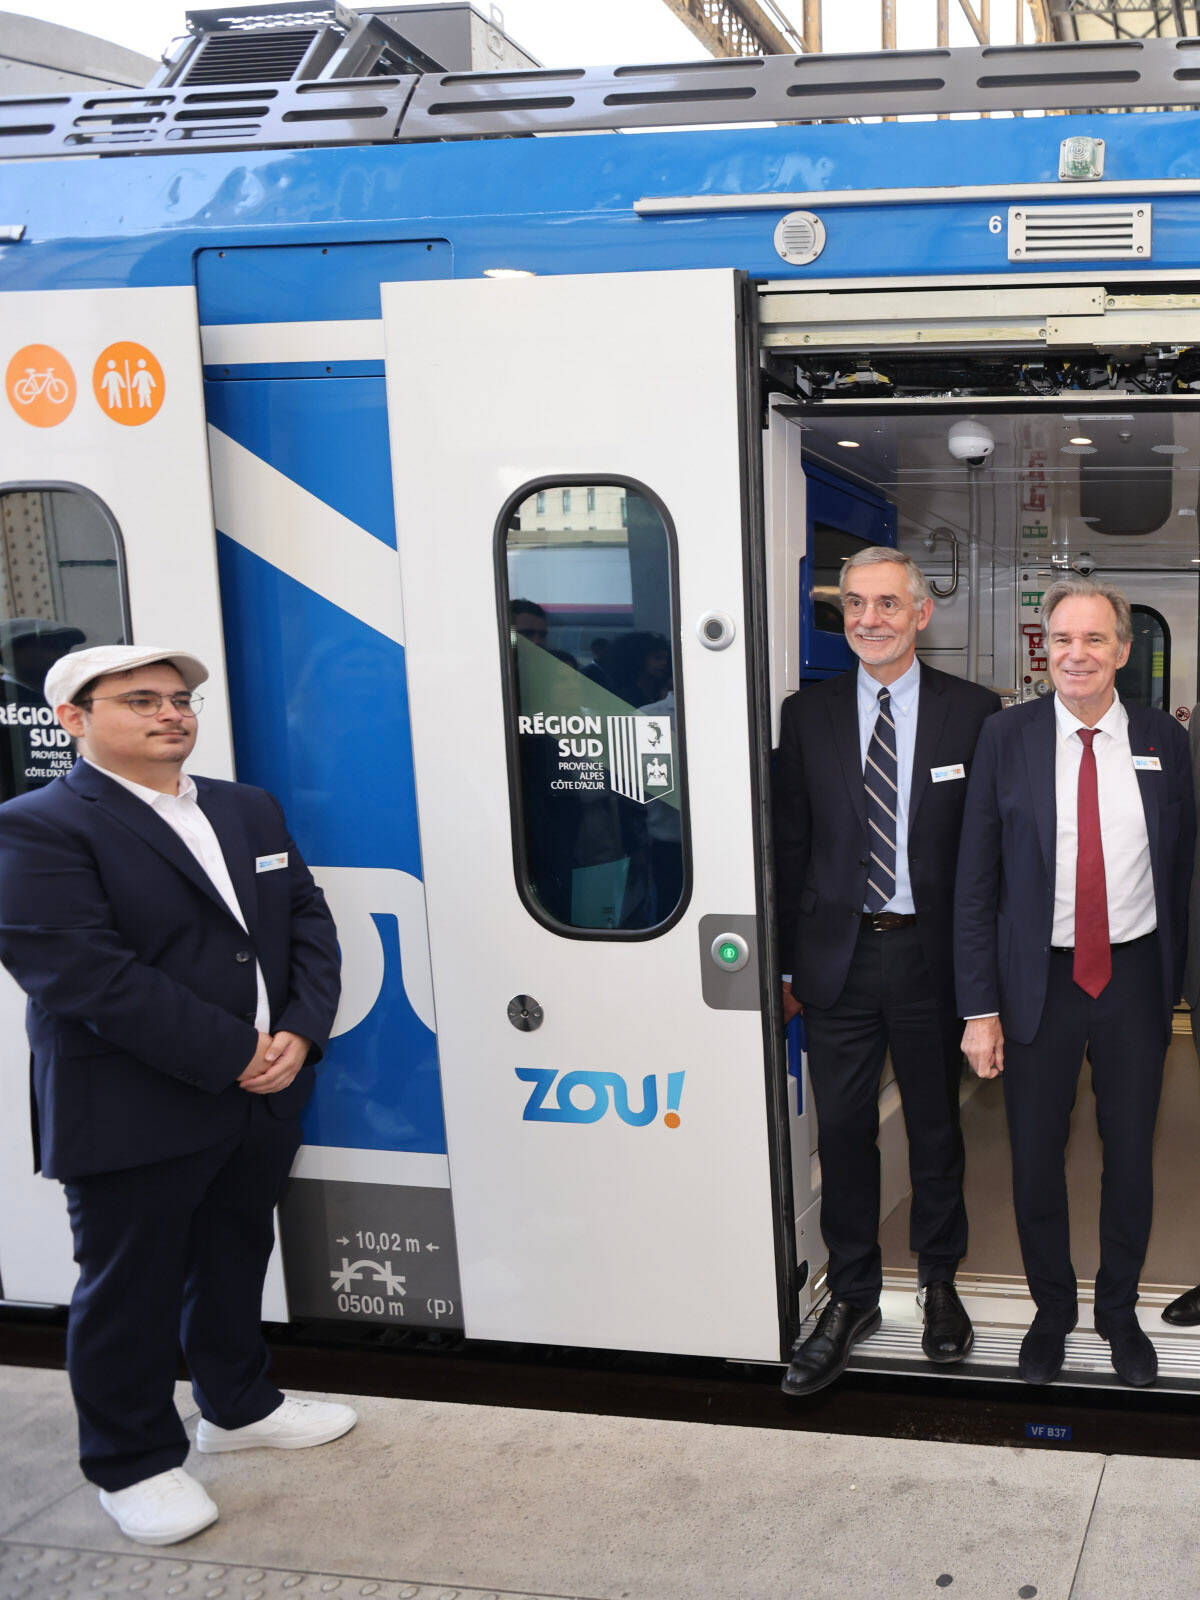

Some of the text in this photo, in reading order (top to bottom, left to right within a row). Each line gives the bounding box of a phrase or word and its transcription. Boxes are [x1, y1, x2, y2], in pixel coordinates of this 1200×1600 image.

[989, 215, 1002, 234] 6
[518, 712, 602, 735] RÉGION
[30, 728, 71, 747] SUD
[31, 750, 72, 760] PROVENCE
[558, 738, 604, 757] SUD
[24, 766, 46, 777] CÔTE
[50, 760, 73, 769] ALPES
[558, 762, 604, 771] PROVENCE
[579, 771, 605, 780] ALPES
[550, 779, 605, 790] CÔTE D'AZUR
[514, 1067, 686, 1129] ZOU!
[355, 1230, 421, 1253] 10,02 m
[337, 1293, 404, 1316] 0500 m
[1031, 1426, 1067, 1437] VF B37
